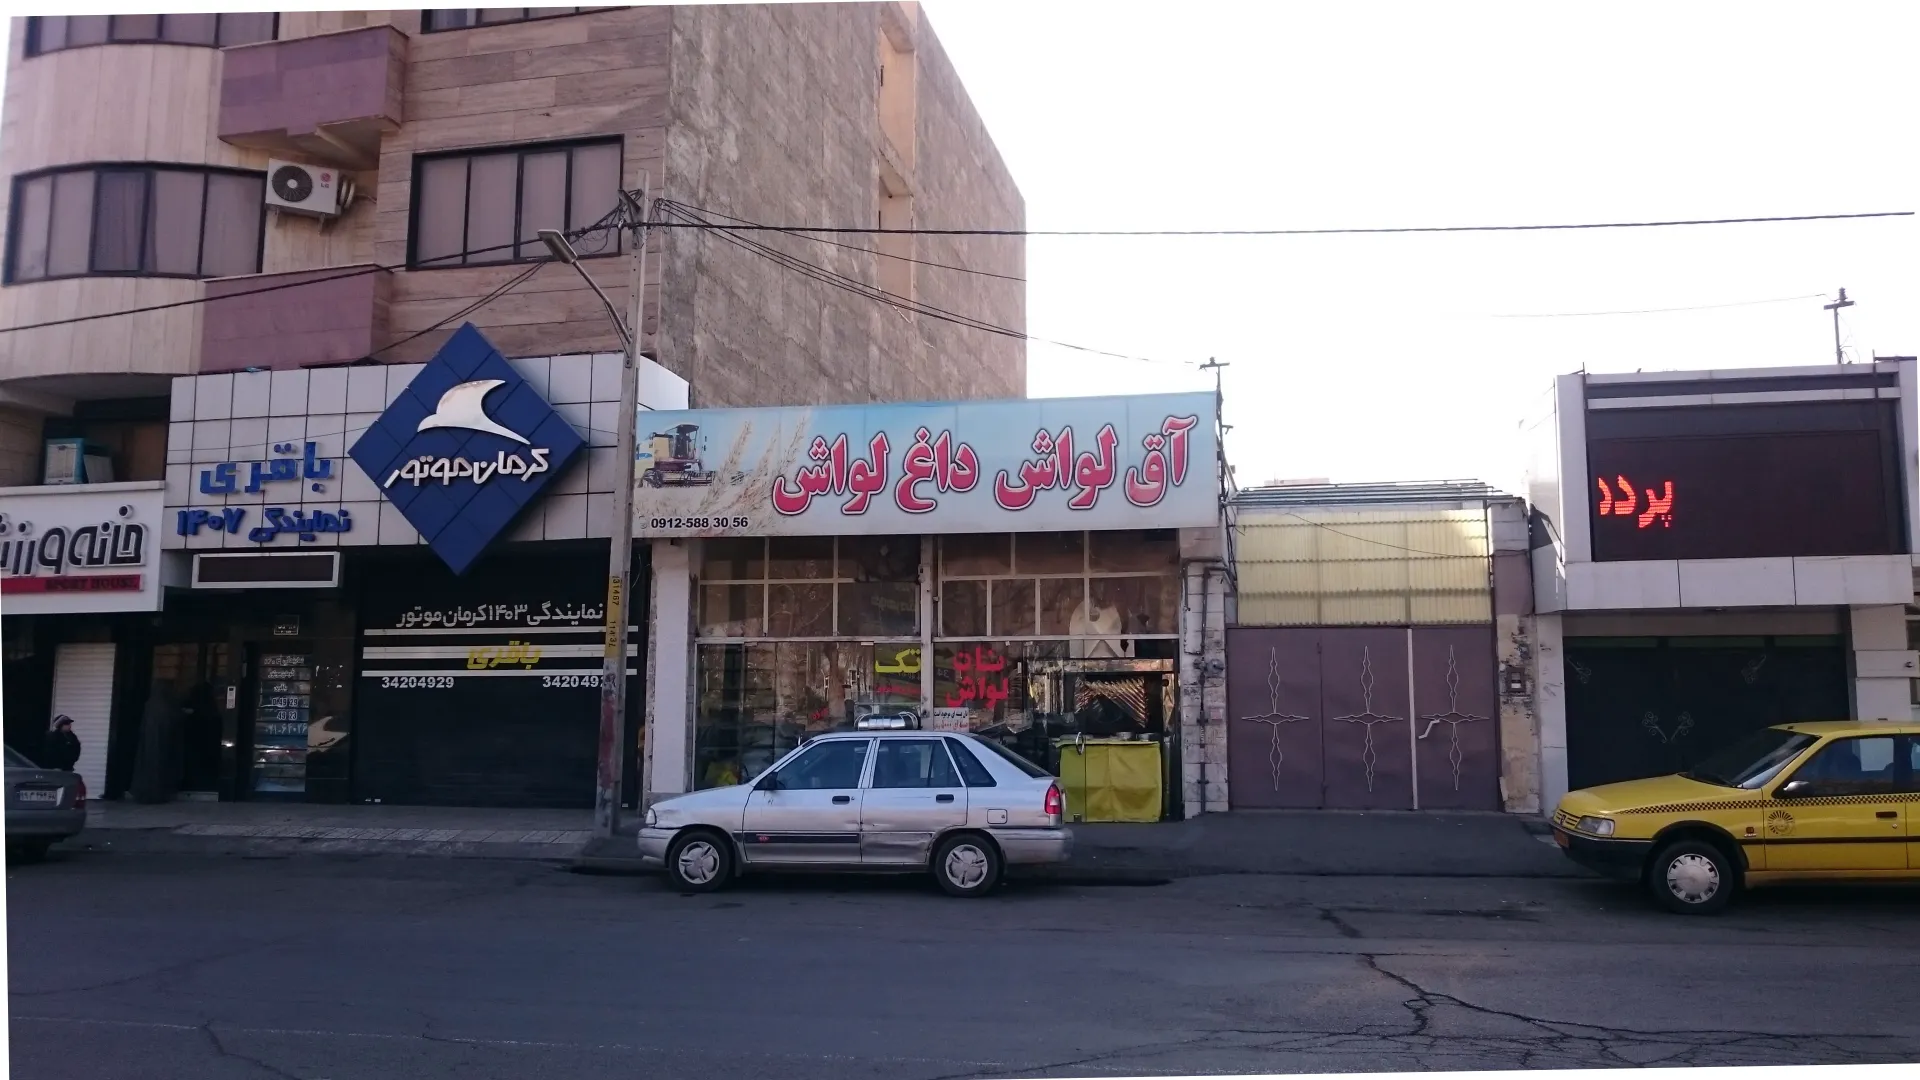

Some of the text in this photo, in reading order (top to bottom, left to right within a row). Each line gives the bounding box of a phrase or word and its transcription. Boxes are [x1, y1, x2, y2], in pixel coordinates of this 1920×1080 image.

[200, 441, 331, 495] باقری
[383, 447, 550, 489] کرمان موتور
[771, 415, 1199, 517] آق لواش داغ لواش
[67, 504, 147, 567] خانه
[248, 507, 353, 543] نمایندگی
[651, 517, 749, 529] 0912-588 30 56
[395, 606, 443, 629] موتور
[442, 603, 488, 627] کرمان
[526, 600, 604, 626] نمایندگی
[466, 641, 542, 670] باقری
[381, 676, 455, 689] 34204929
[542, 675, 604, 688] 342049
[945, 676, 1009, 709] لواش
